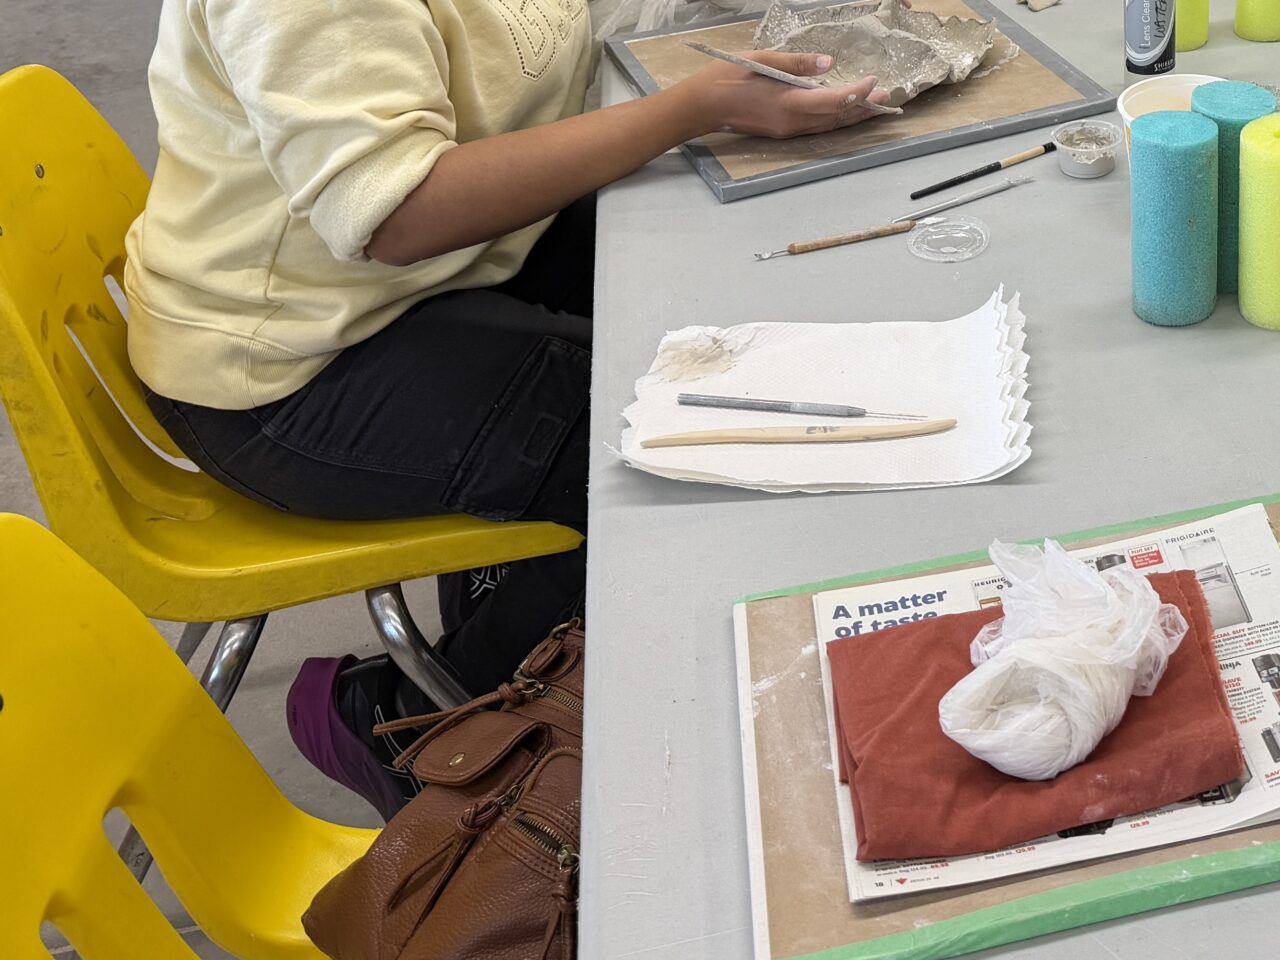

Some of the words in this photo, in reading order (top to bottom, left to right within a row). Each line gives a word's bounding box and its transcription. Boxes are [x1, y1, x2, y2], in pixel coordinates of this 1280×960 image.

[1140, 24, 1151, 47] Lens
[1165, 527, 1215, 544] FRIGIDAIRE
[832, 605, 852, 620] A
[858, 590, 947, 617] matter
[834, 621, 863, 639] of
[1232, 628, 1246, 636] BUY
